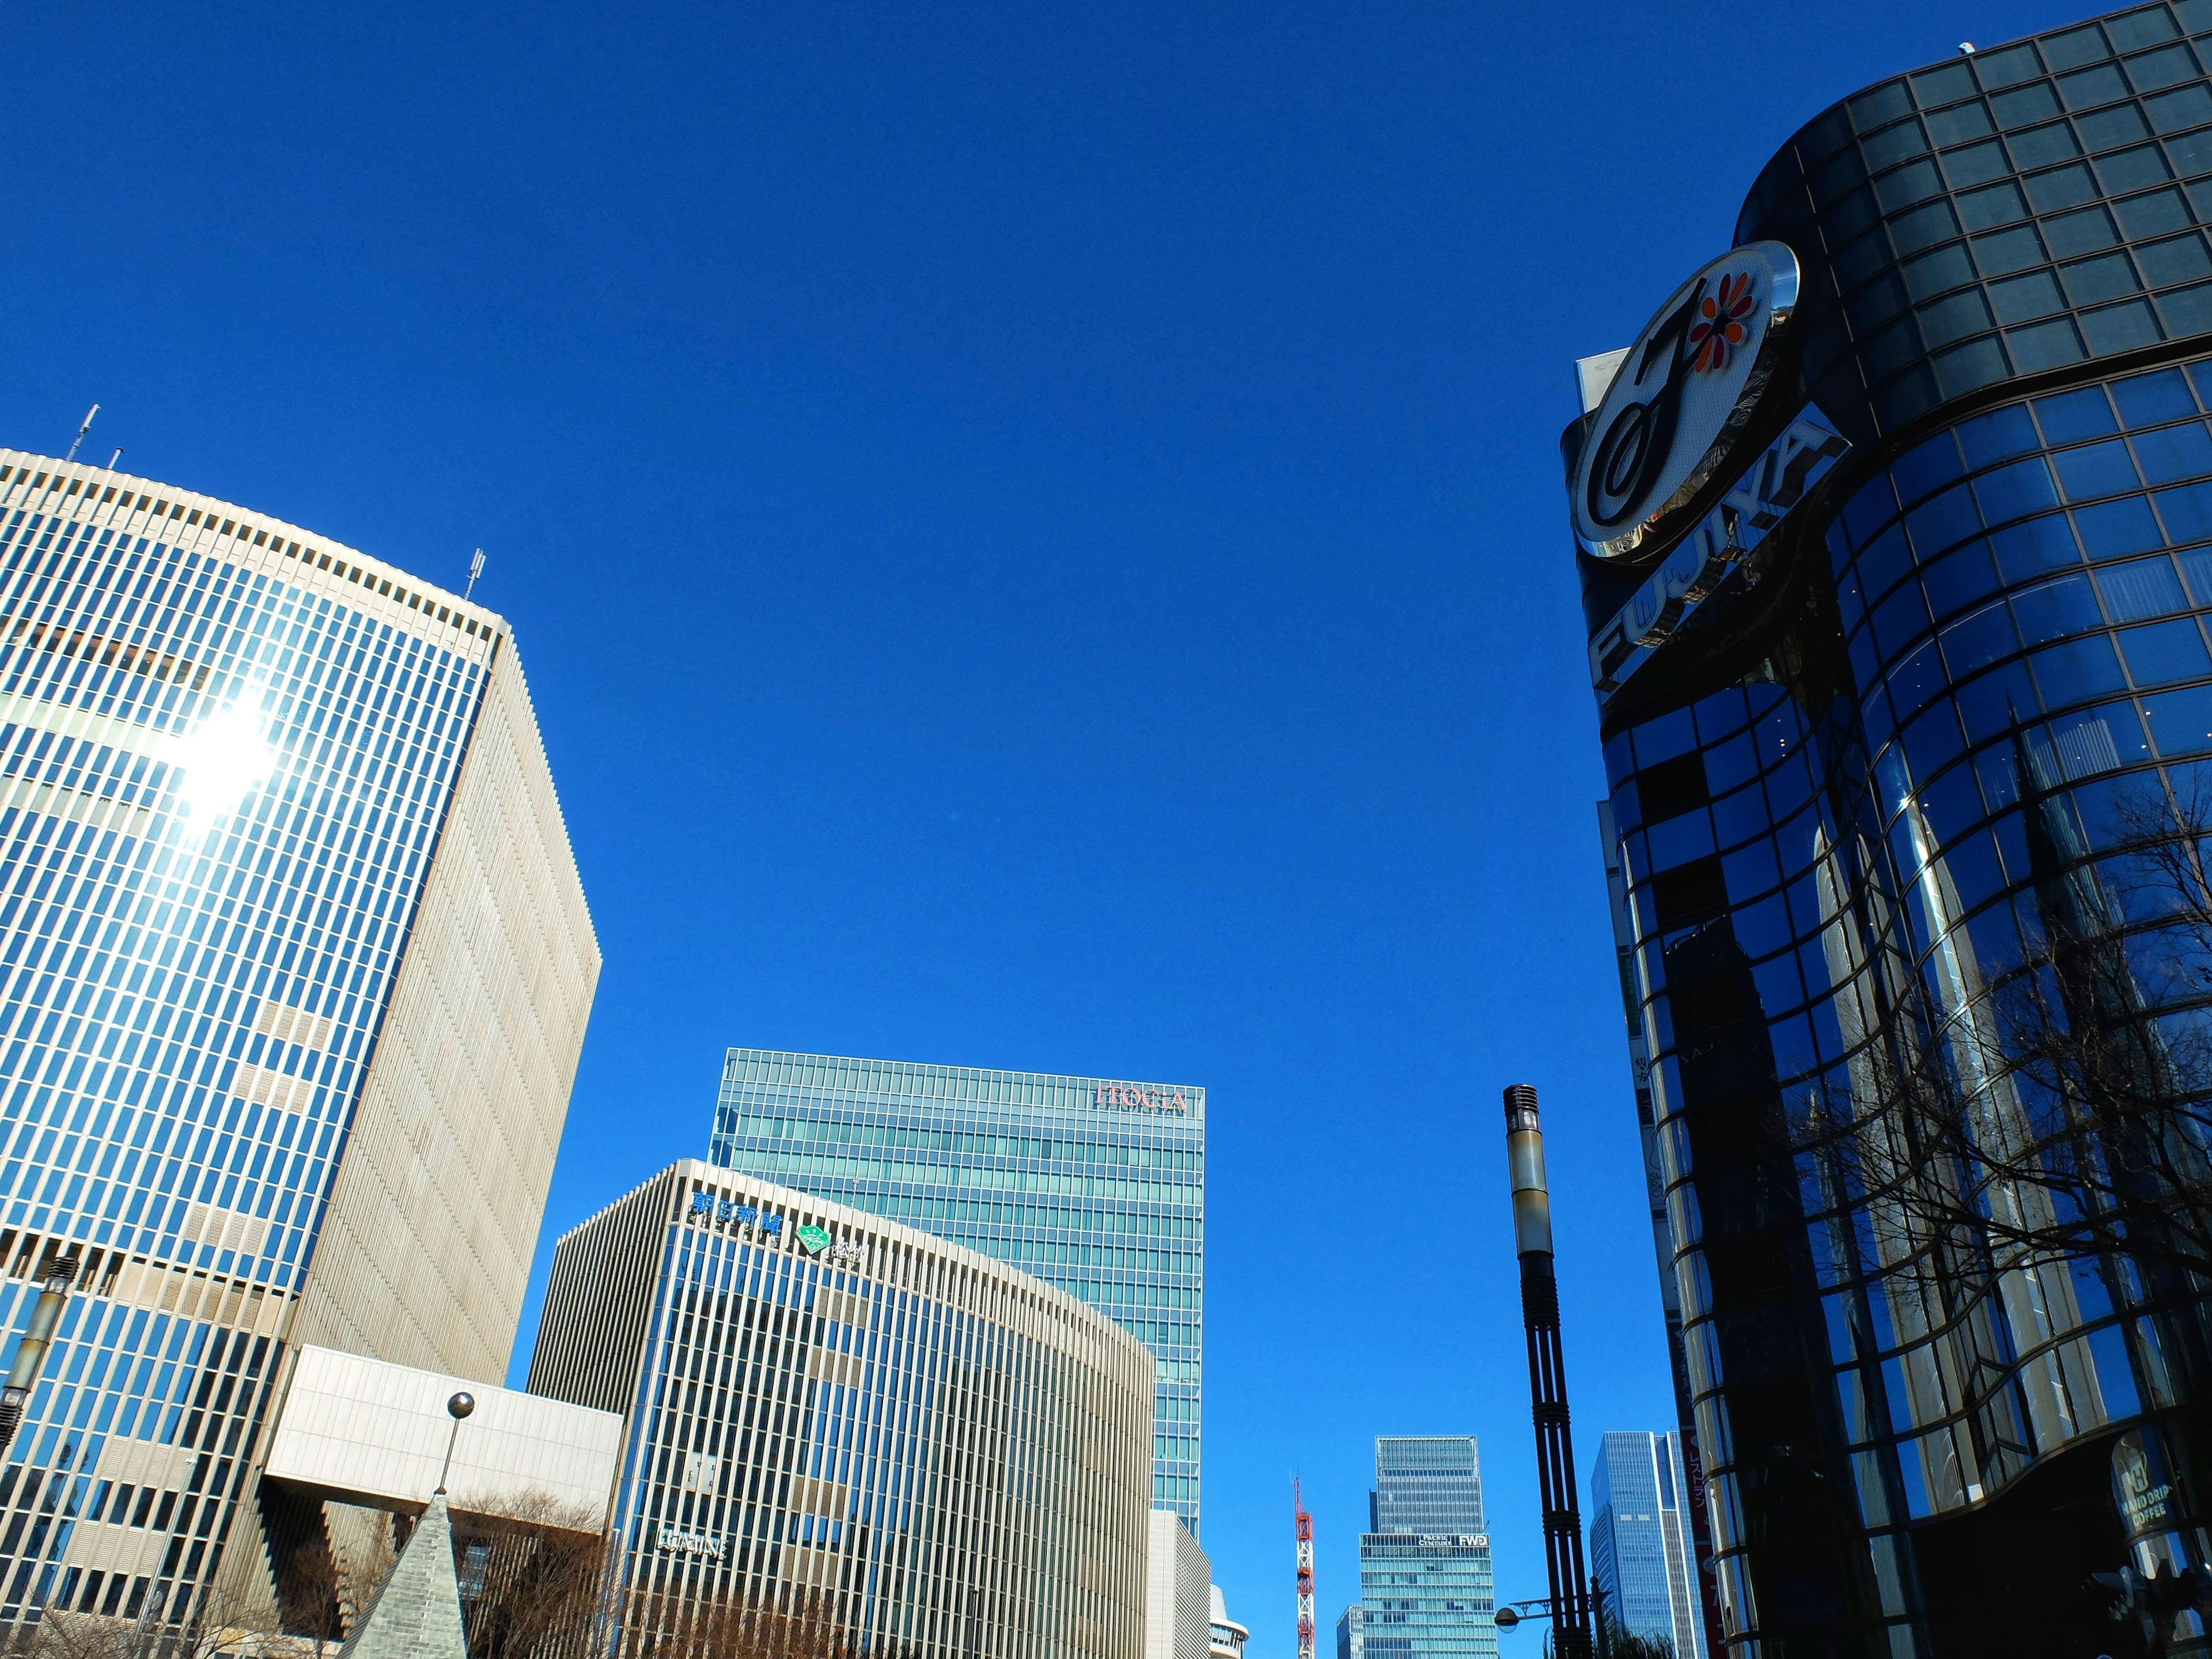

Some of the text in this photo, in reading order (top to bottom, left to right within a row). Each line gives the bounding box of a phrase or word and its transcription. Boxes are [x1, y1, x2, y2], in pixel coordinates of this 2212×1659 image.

[1589, 418, 1848, 693] FUJIYA
[692, 1191, 783, 1236] 朝日新聞
[1689, 1451, 1705, 1508] レストラン
[2120, 1495, 2147, 1516] HAND
[2132, 1502, 2166, 1527] COFFEE
[657, 1528, 728, 1559] LUMINE
[1459, 1535, 1487, 1546] FWD
